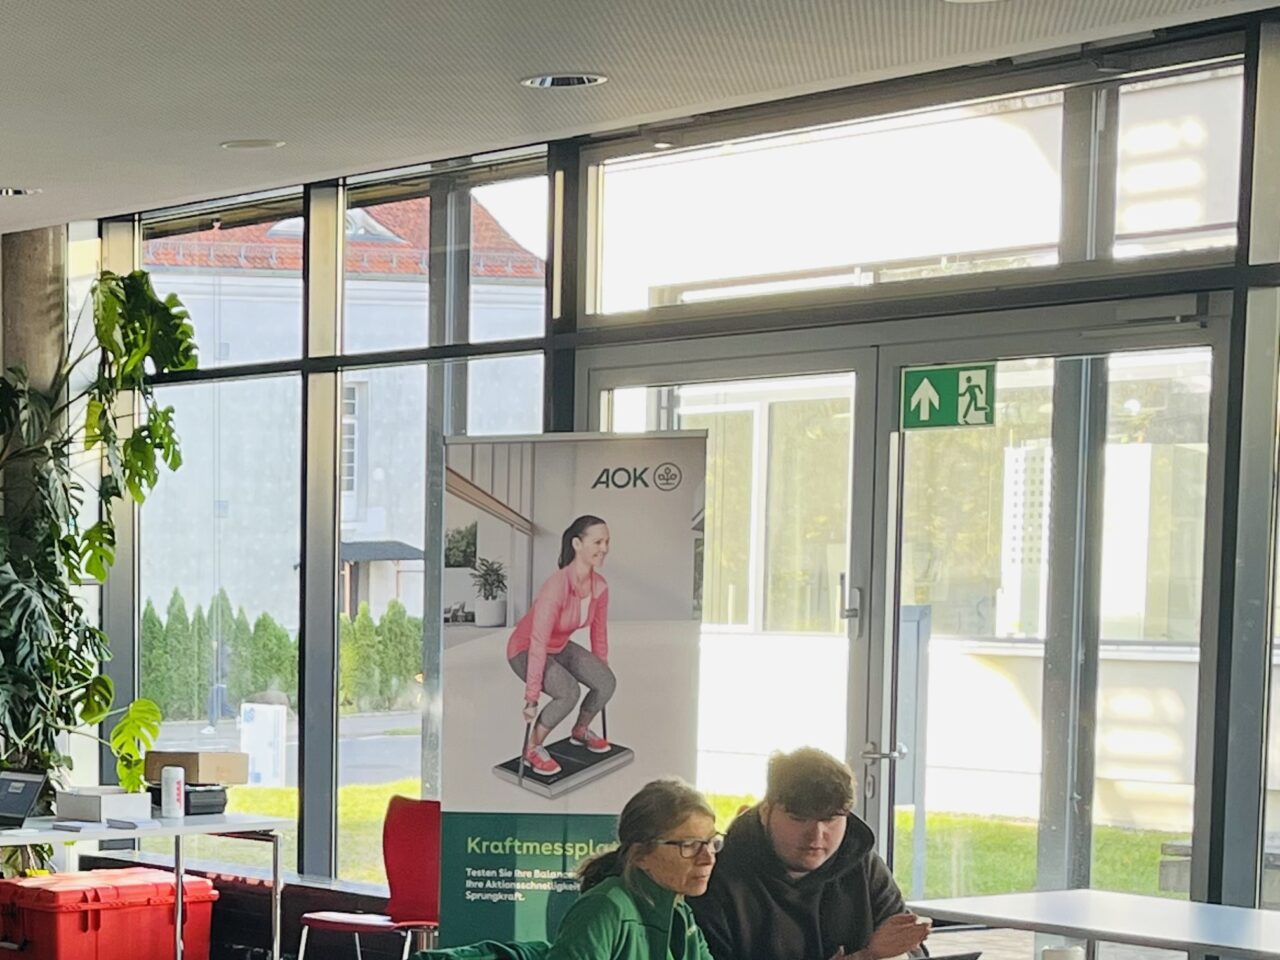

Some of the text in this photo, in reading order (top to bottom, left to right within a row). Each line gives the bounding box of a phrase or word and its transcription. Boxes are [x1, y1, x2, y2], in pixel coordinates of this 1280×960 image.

[591, 467, 650, 489] AOK
[467, 836, 618, 860] Kraftmesspla
[465, 867, 498, 878] Testen
[498, 867, 513, 878] Sie
[514, 867, 532, 878] Ihre
[465, 879, 484, 889] Ihre
[465, 890, 526, 903] Sprungkraft.
